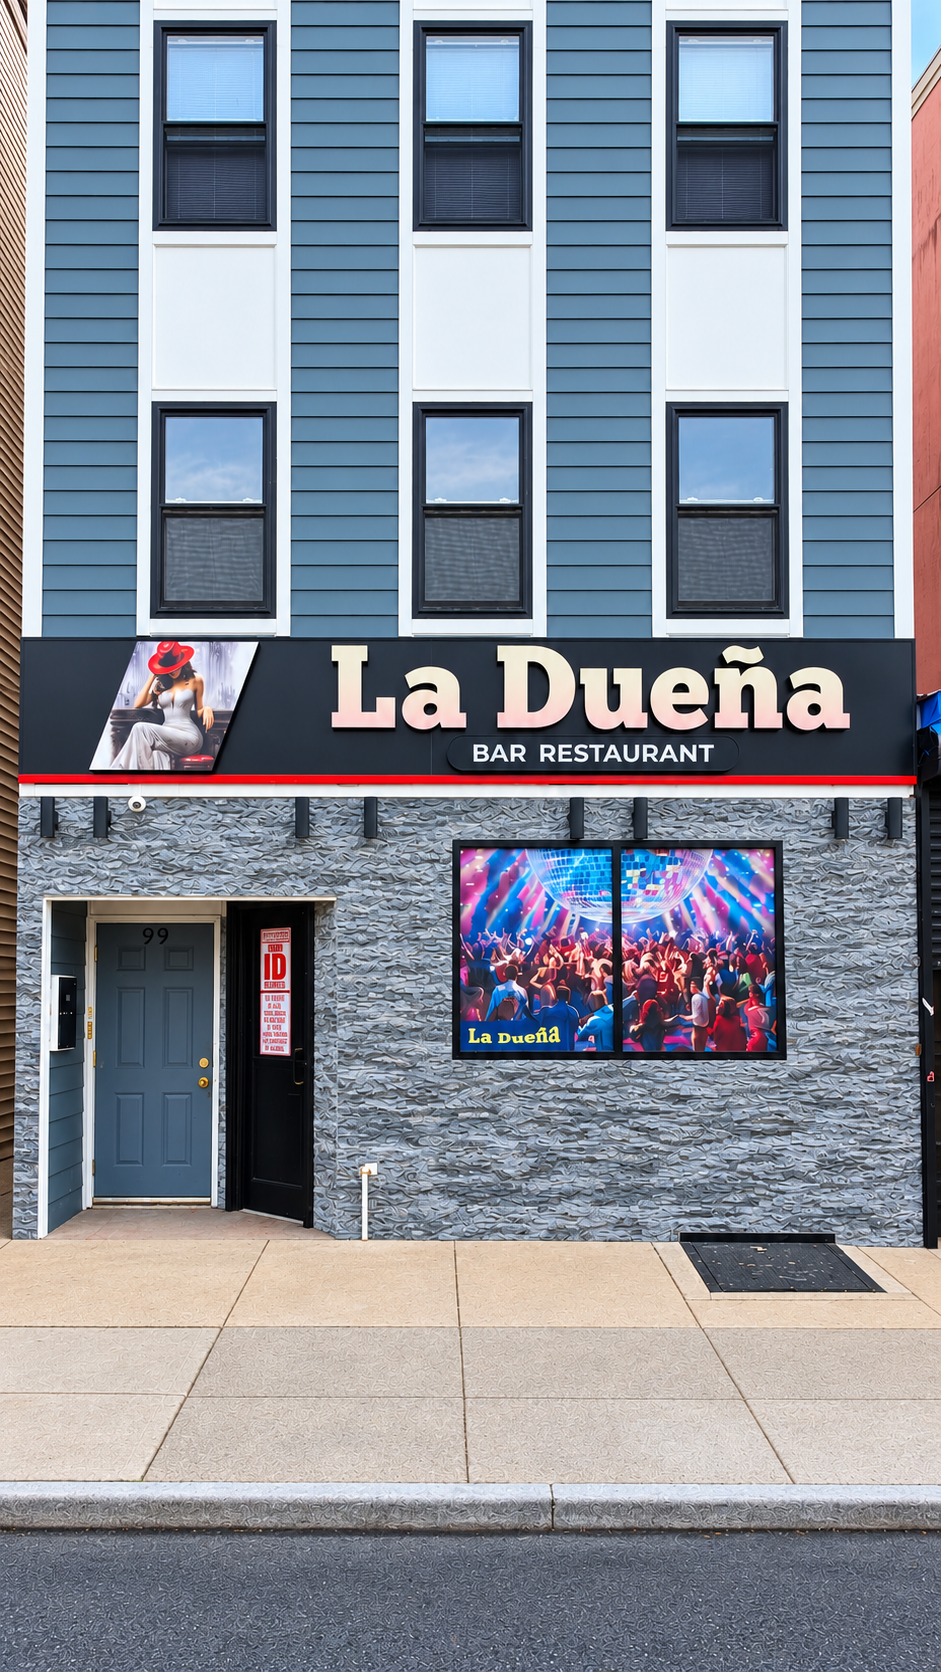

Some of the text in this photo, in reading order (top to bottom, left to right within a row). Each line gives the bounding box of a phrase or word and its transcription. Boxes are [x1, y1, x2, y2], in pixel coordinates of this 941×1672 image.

[331, 644, 851, 731] La Dueña
[473, 744, 714, 763] BAR RESTAURANT
[142, 927, 169, 945] 99
[264, 953, 287, 980] ID
[468, 1025, 561, 1044] La Dueña
